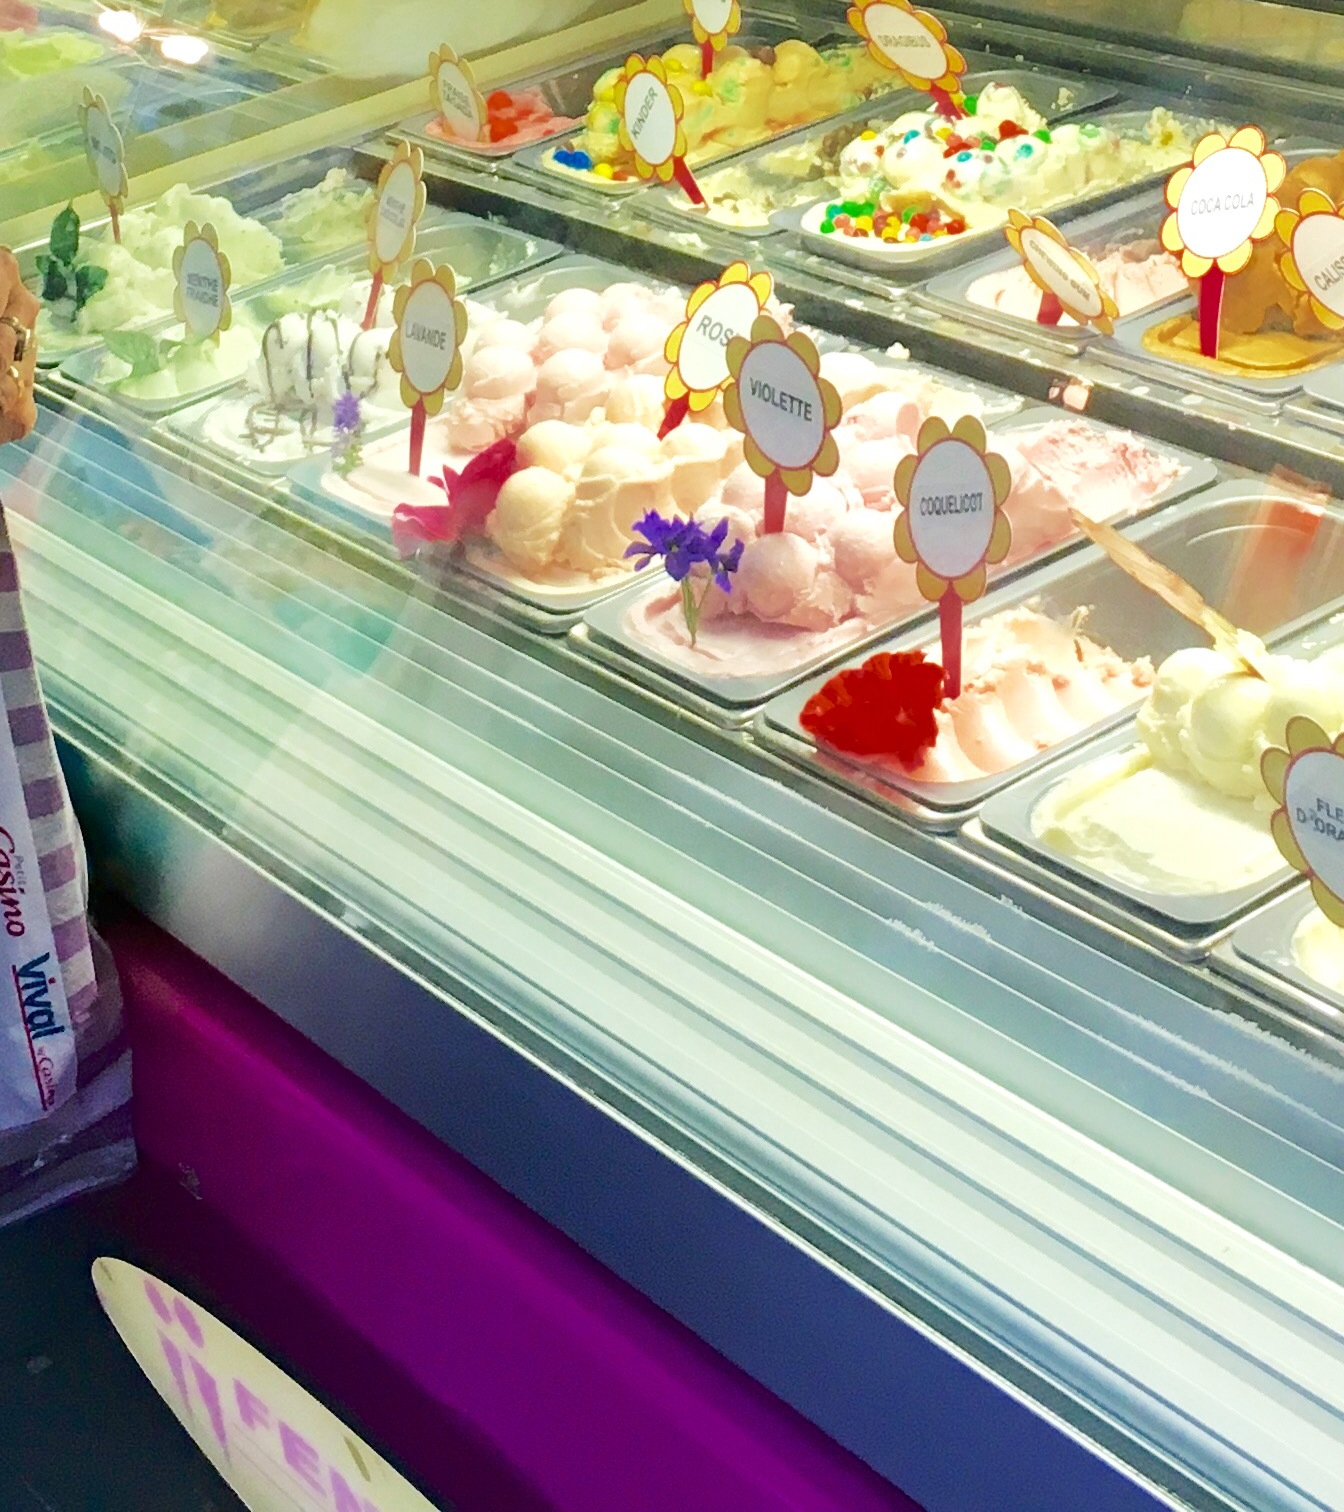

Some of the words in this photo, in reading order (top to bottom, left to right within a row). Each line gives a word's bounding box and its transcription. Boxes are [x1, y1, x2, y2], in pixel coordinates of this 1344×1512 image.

[631, 86, 658, 140] KINDER
[1190, 194, 1221, 217] COCA
[1223, 190, 1255, 214] COLA
[1070, 278, 1091, 301] GUM
[405, 319, 447, 351] LAVANDE
[696, 314, 734, 347] ROS
[749, 376, 813, 422] VIOLETTE
[918, 493, 984, 518] COQUELICOT
[17, 950, 66, 1041] Vival
